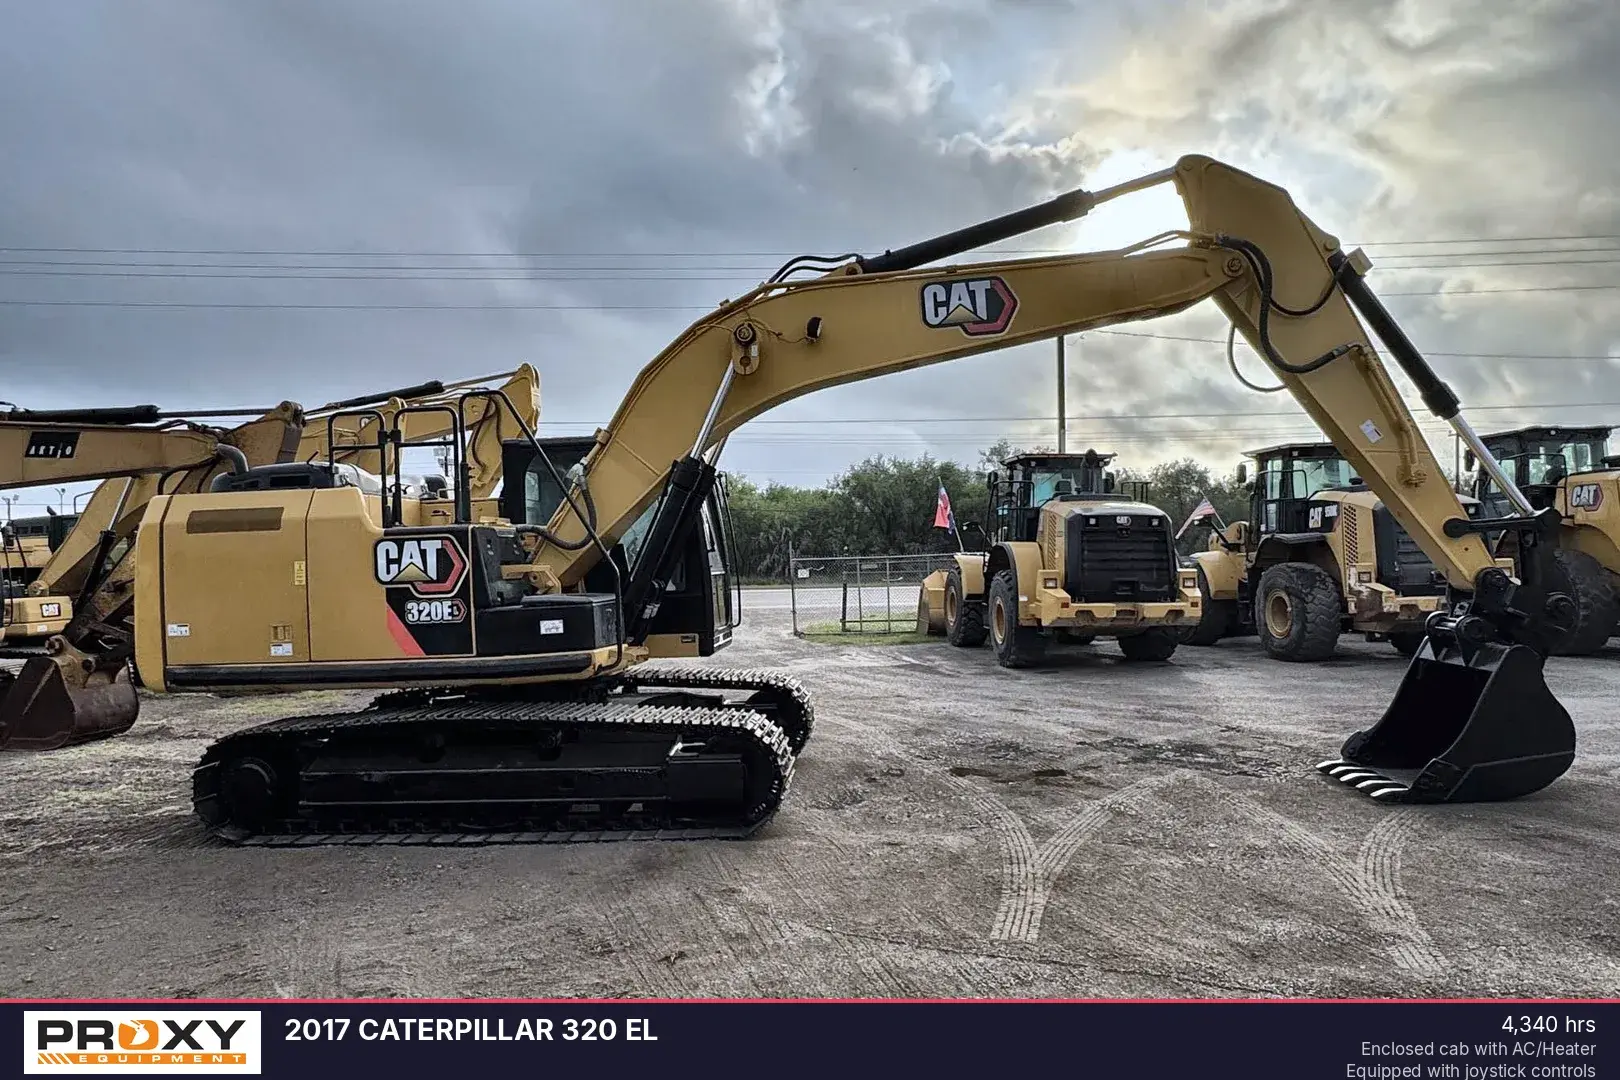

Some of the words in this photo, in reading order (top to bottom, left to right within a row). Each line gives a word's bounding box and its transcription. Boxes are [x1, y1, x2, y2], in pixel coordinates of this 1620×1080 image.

[923, 280, 991, 325] CAT
[1572, 485, 1597, 506] CAT
[1309, 506, 1323, 529] CAT
[376, 539, 443, 582] CAT
